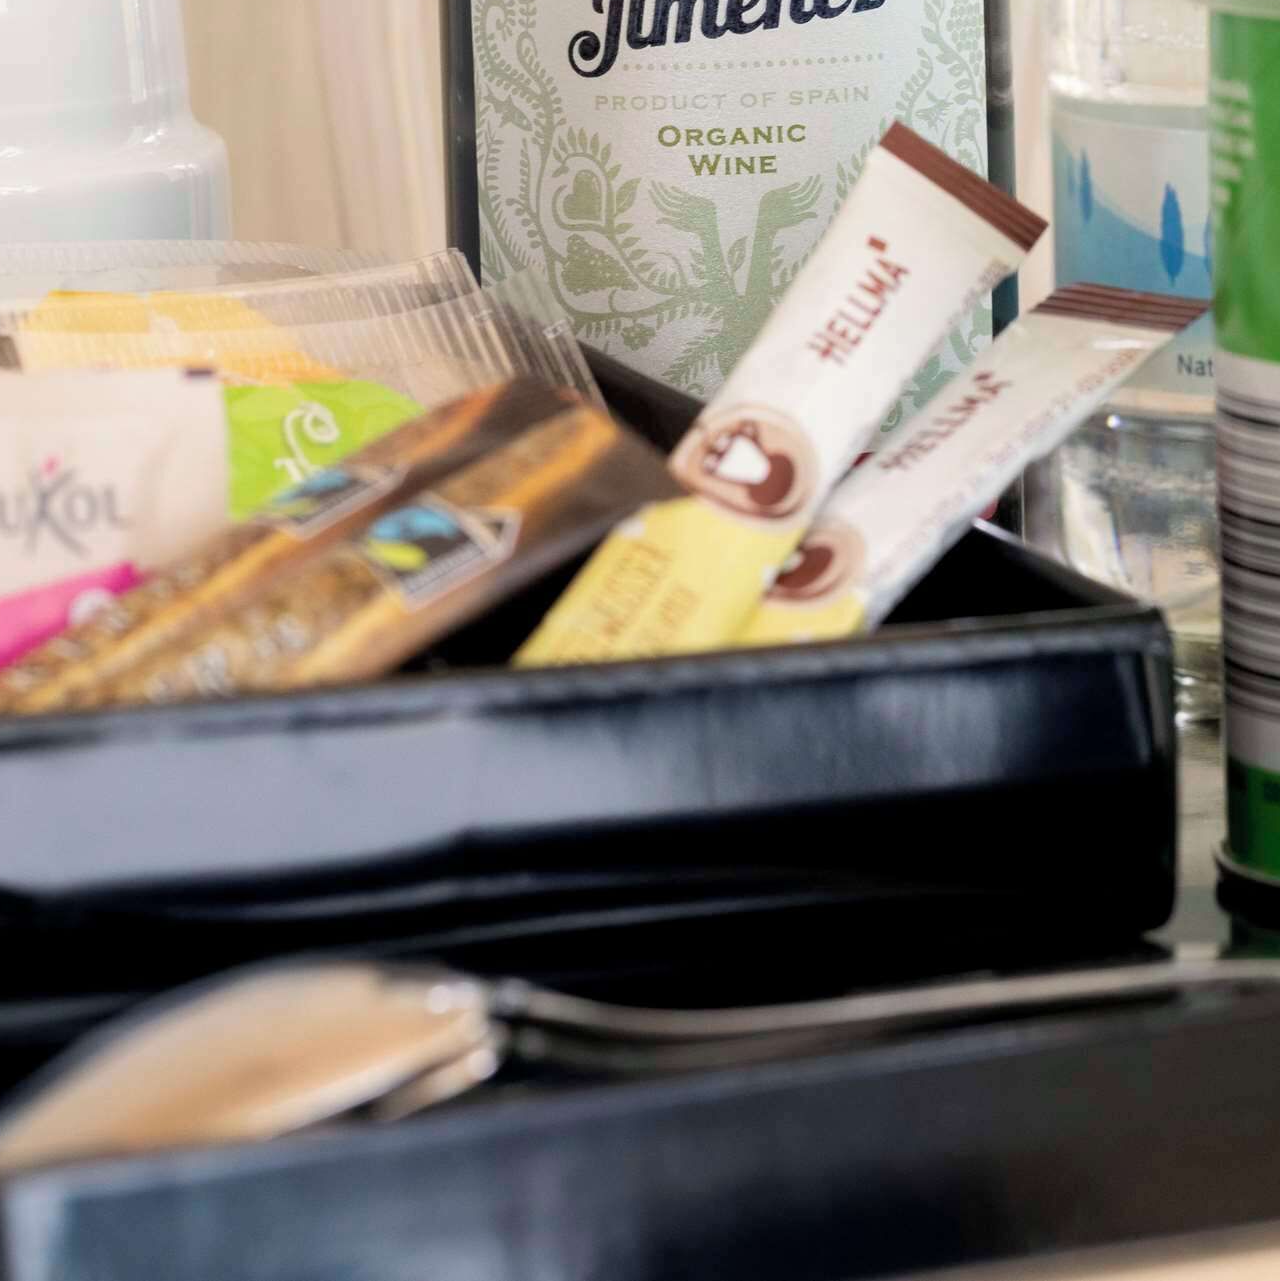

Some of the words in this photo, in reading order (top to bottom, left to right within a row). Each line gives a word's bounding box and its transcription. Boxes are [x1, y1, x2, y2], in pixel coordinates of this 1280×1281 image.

[594, 93, 728, 113] PRODUCT
[739, 90, 776, 110] OF
[788, 84, 870, 107] SPAIN
[657, 124, 807, 148] ORGANIC
[687, 153, 778, 176] WINE
[806, 257, 912, 367] HELLMA
[1176, 354, 1215, 377] Nat
